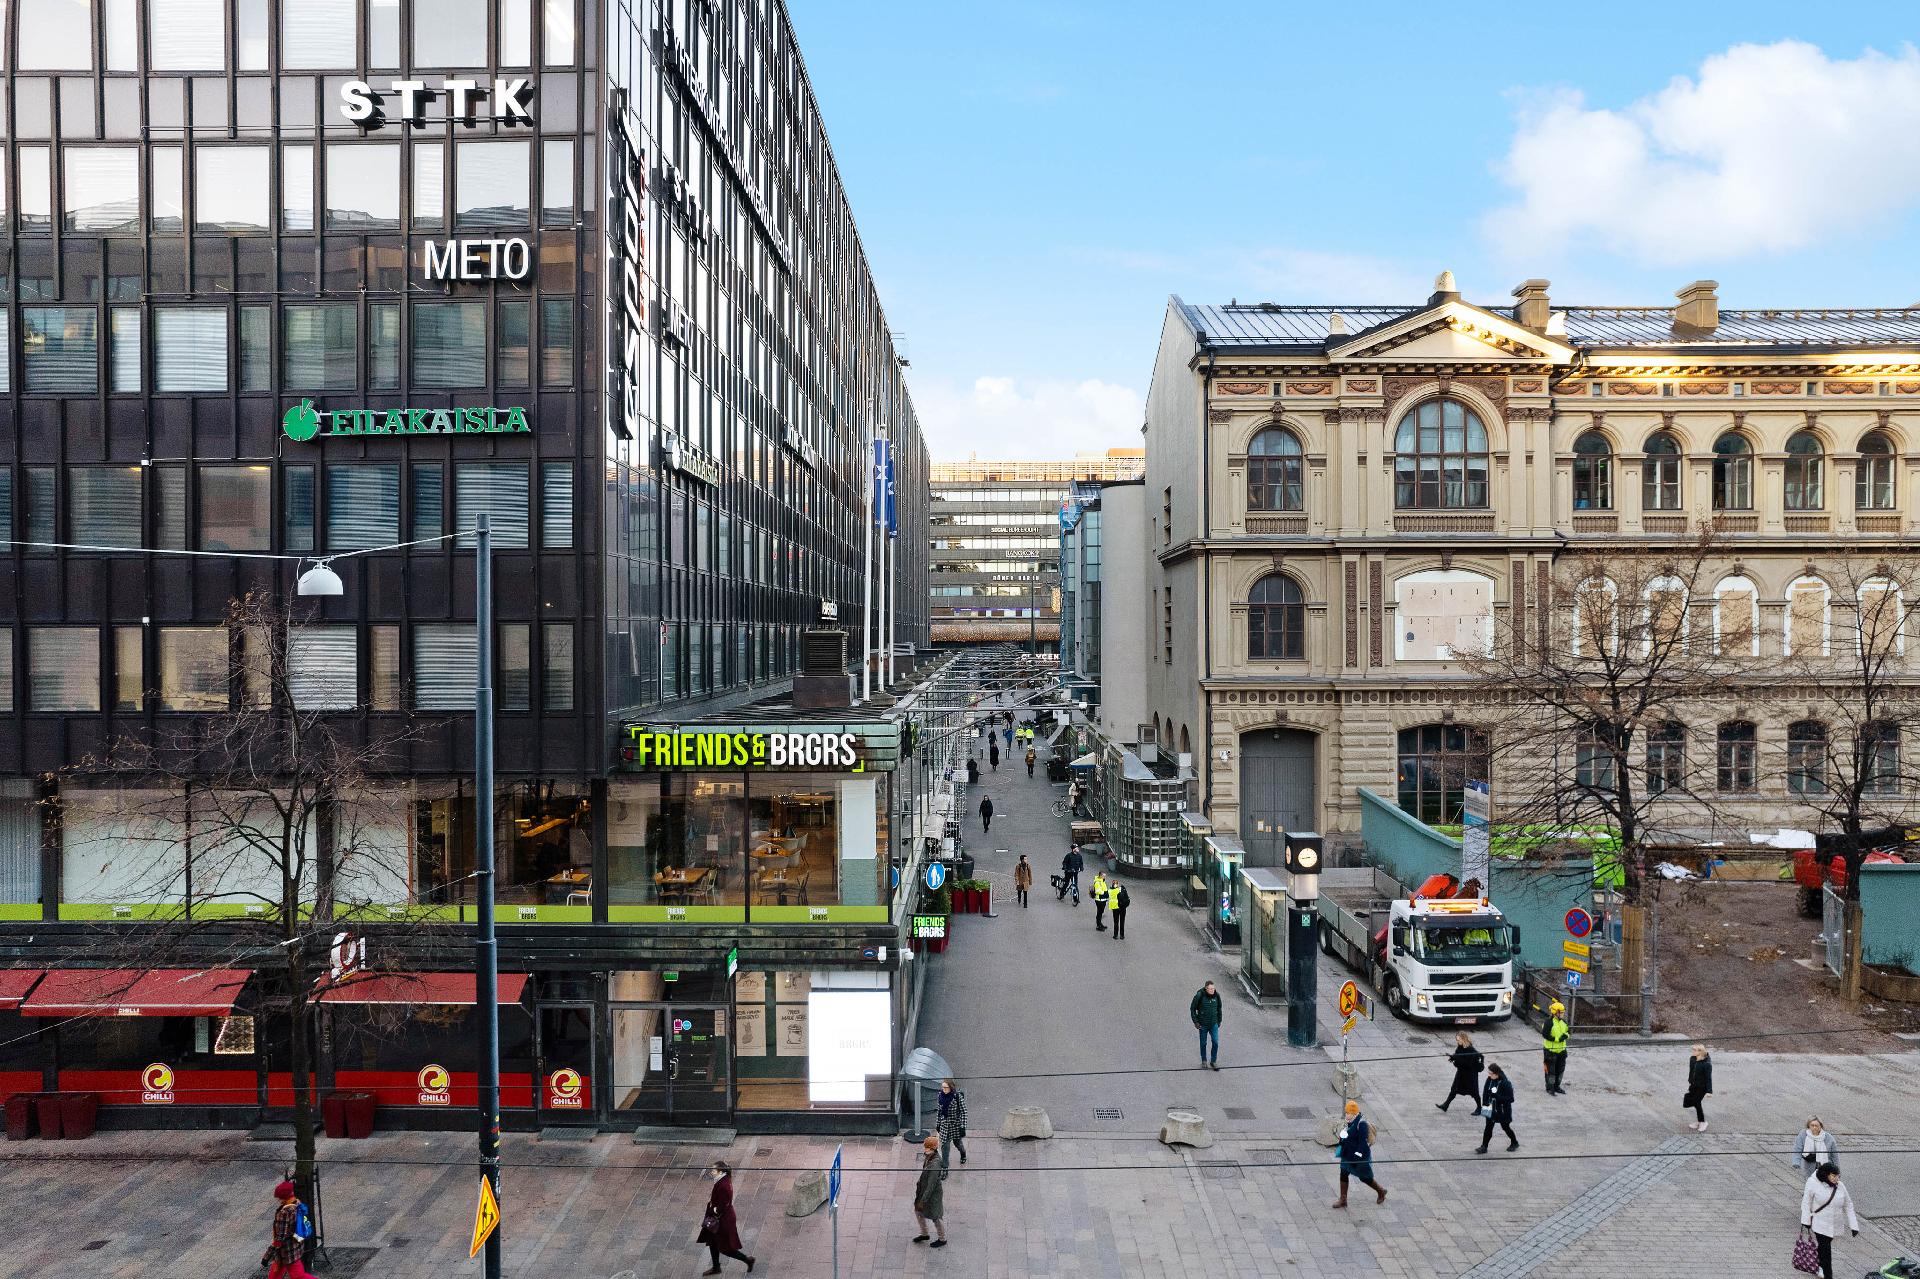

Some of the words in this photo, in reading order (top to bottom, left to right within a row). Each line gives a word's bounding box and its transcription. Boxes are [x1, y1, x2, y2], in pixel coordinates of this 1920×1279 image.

[340, 79, 528, 120] STTK
[425, 238, 529, 280] METO
[331, 407, 531, 434] EILAKAISLA
[640, 733, 748, 765] FRIENDS
[753, 734, 766, 765] &
[771, 733, 857, 765] BRGRS
[914, 917, 944, 926] FRIENDS
[919, 927, 944, 937] BRGRS
